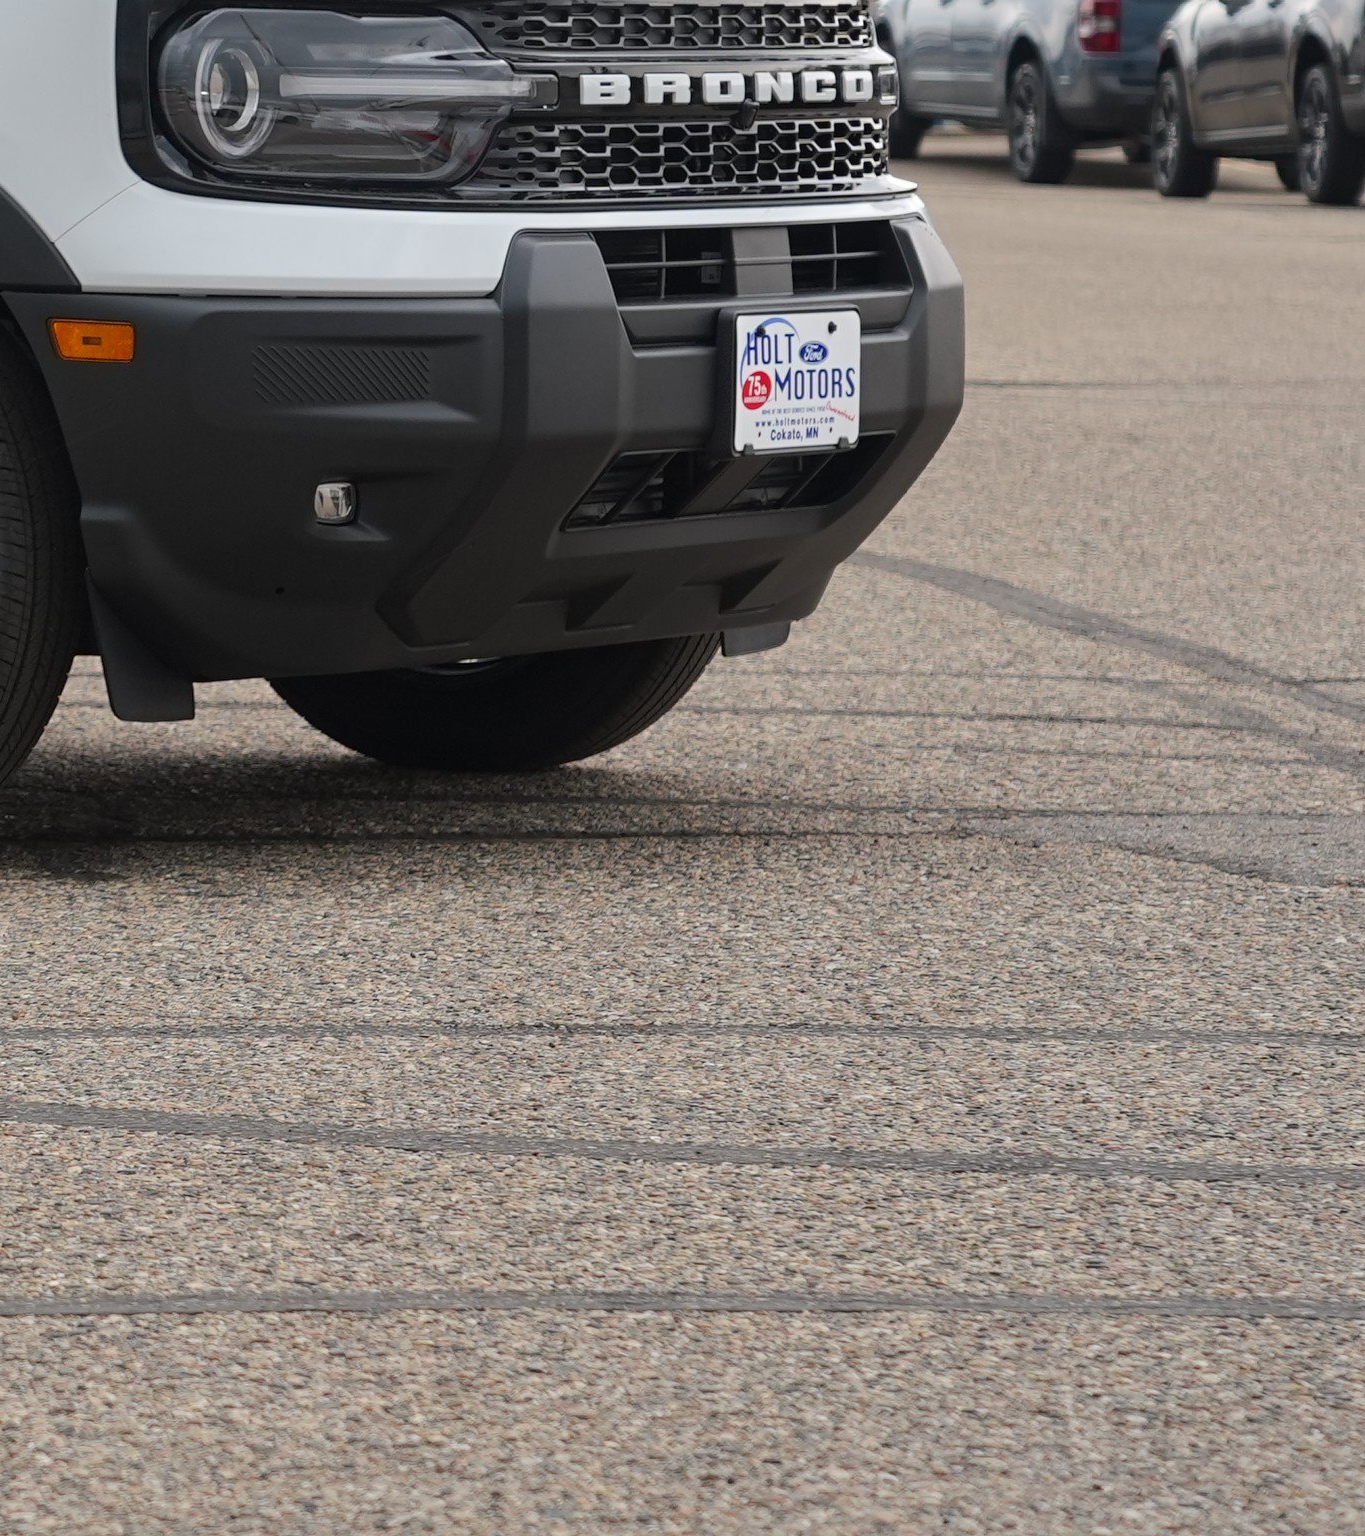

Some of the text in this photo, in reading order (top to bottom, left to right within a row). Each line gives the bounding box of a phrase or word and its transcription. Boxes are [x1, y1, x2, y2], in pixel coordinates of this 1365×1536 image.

[579, 70, 873, 105] BRONCO
[747, 332, 795, 366] HOLT
[803, 345, 824, 361] Ford
[774, 367, 856, 402] MOTORS
[755, 416, 835, 428] www.holtmotors.com
[770, 427, 819, 442] Cokato, MN
